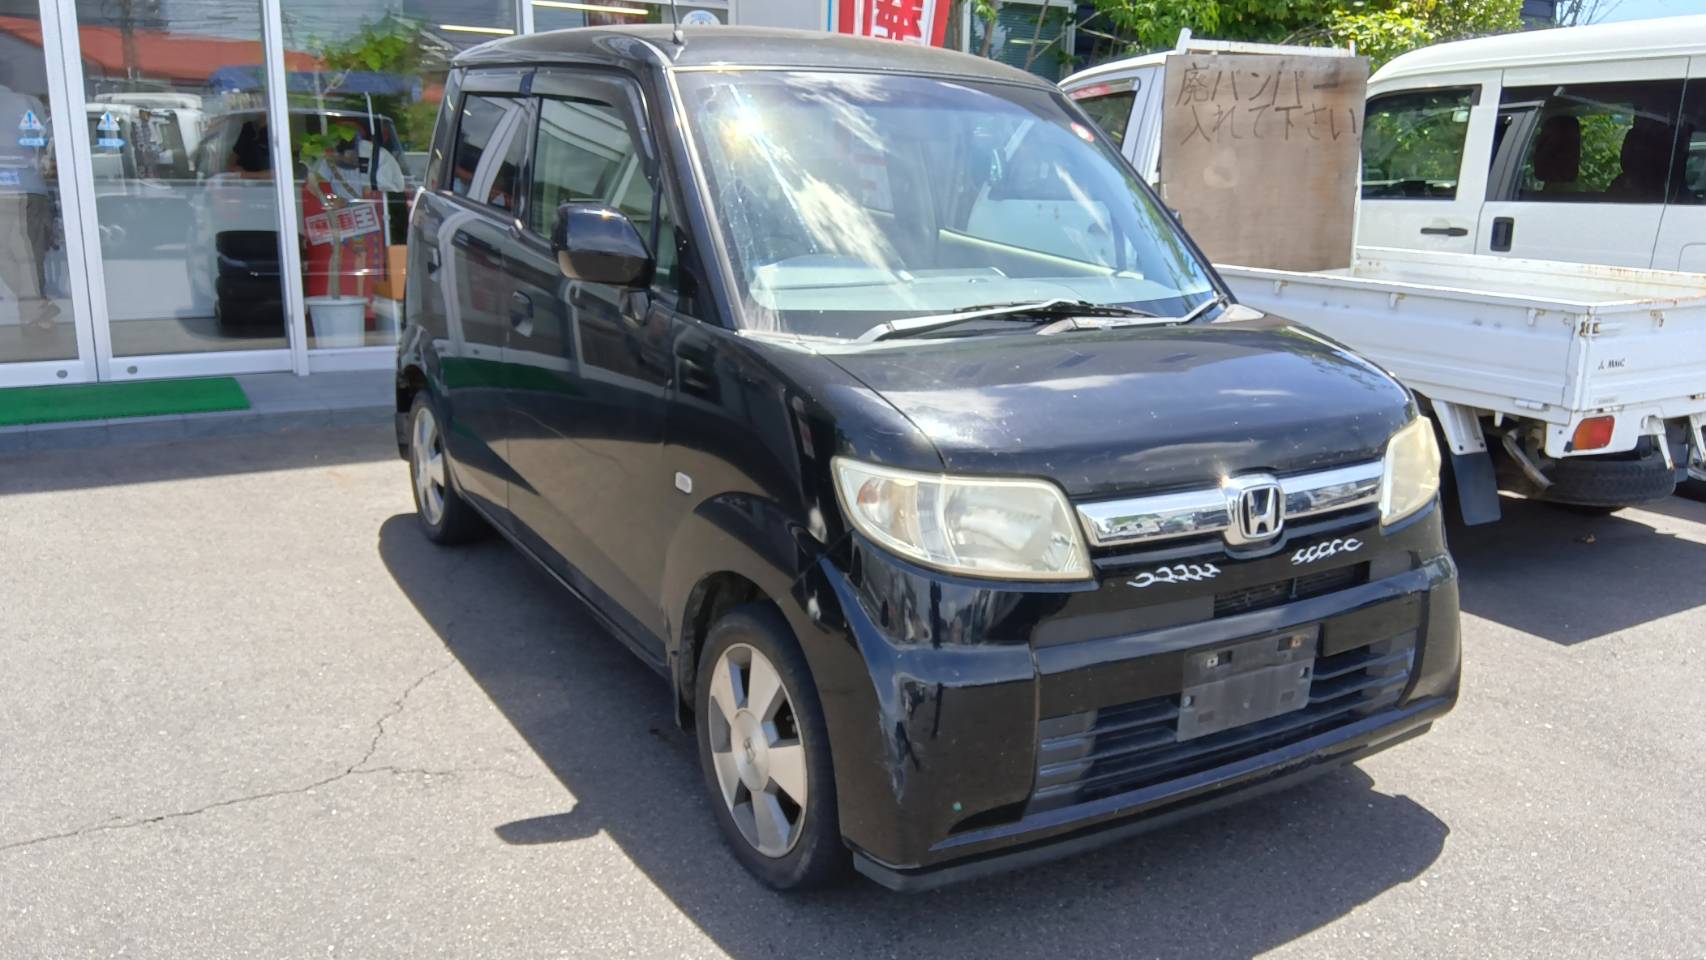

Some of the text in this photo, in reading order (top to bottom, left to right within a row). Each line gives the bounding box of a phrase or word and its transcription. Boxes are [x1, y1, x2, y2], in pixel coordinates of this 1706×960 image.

[1176, 62, 1339, 106] 廃バンパー
[1180, 103, 1357, 145] 入れて下さい
